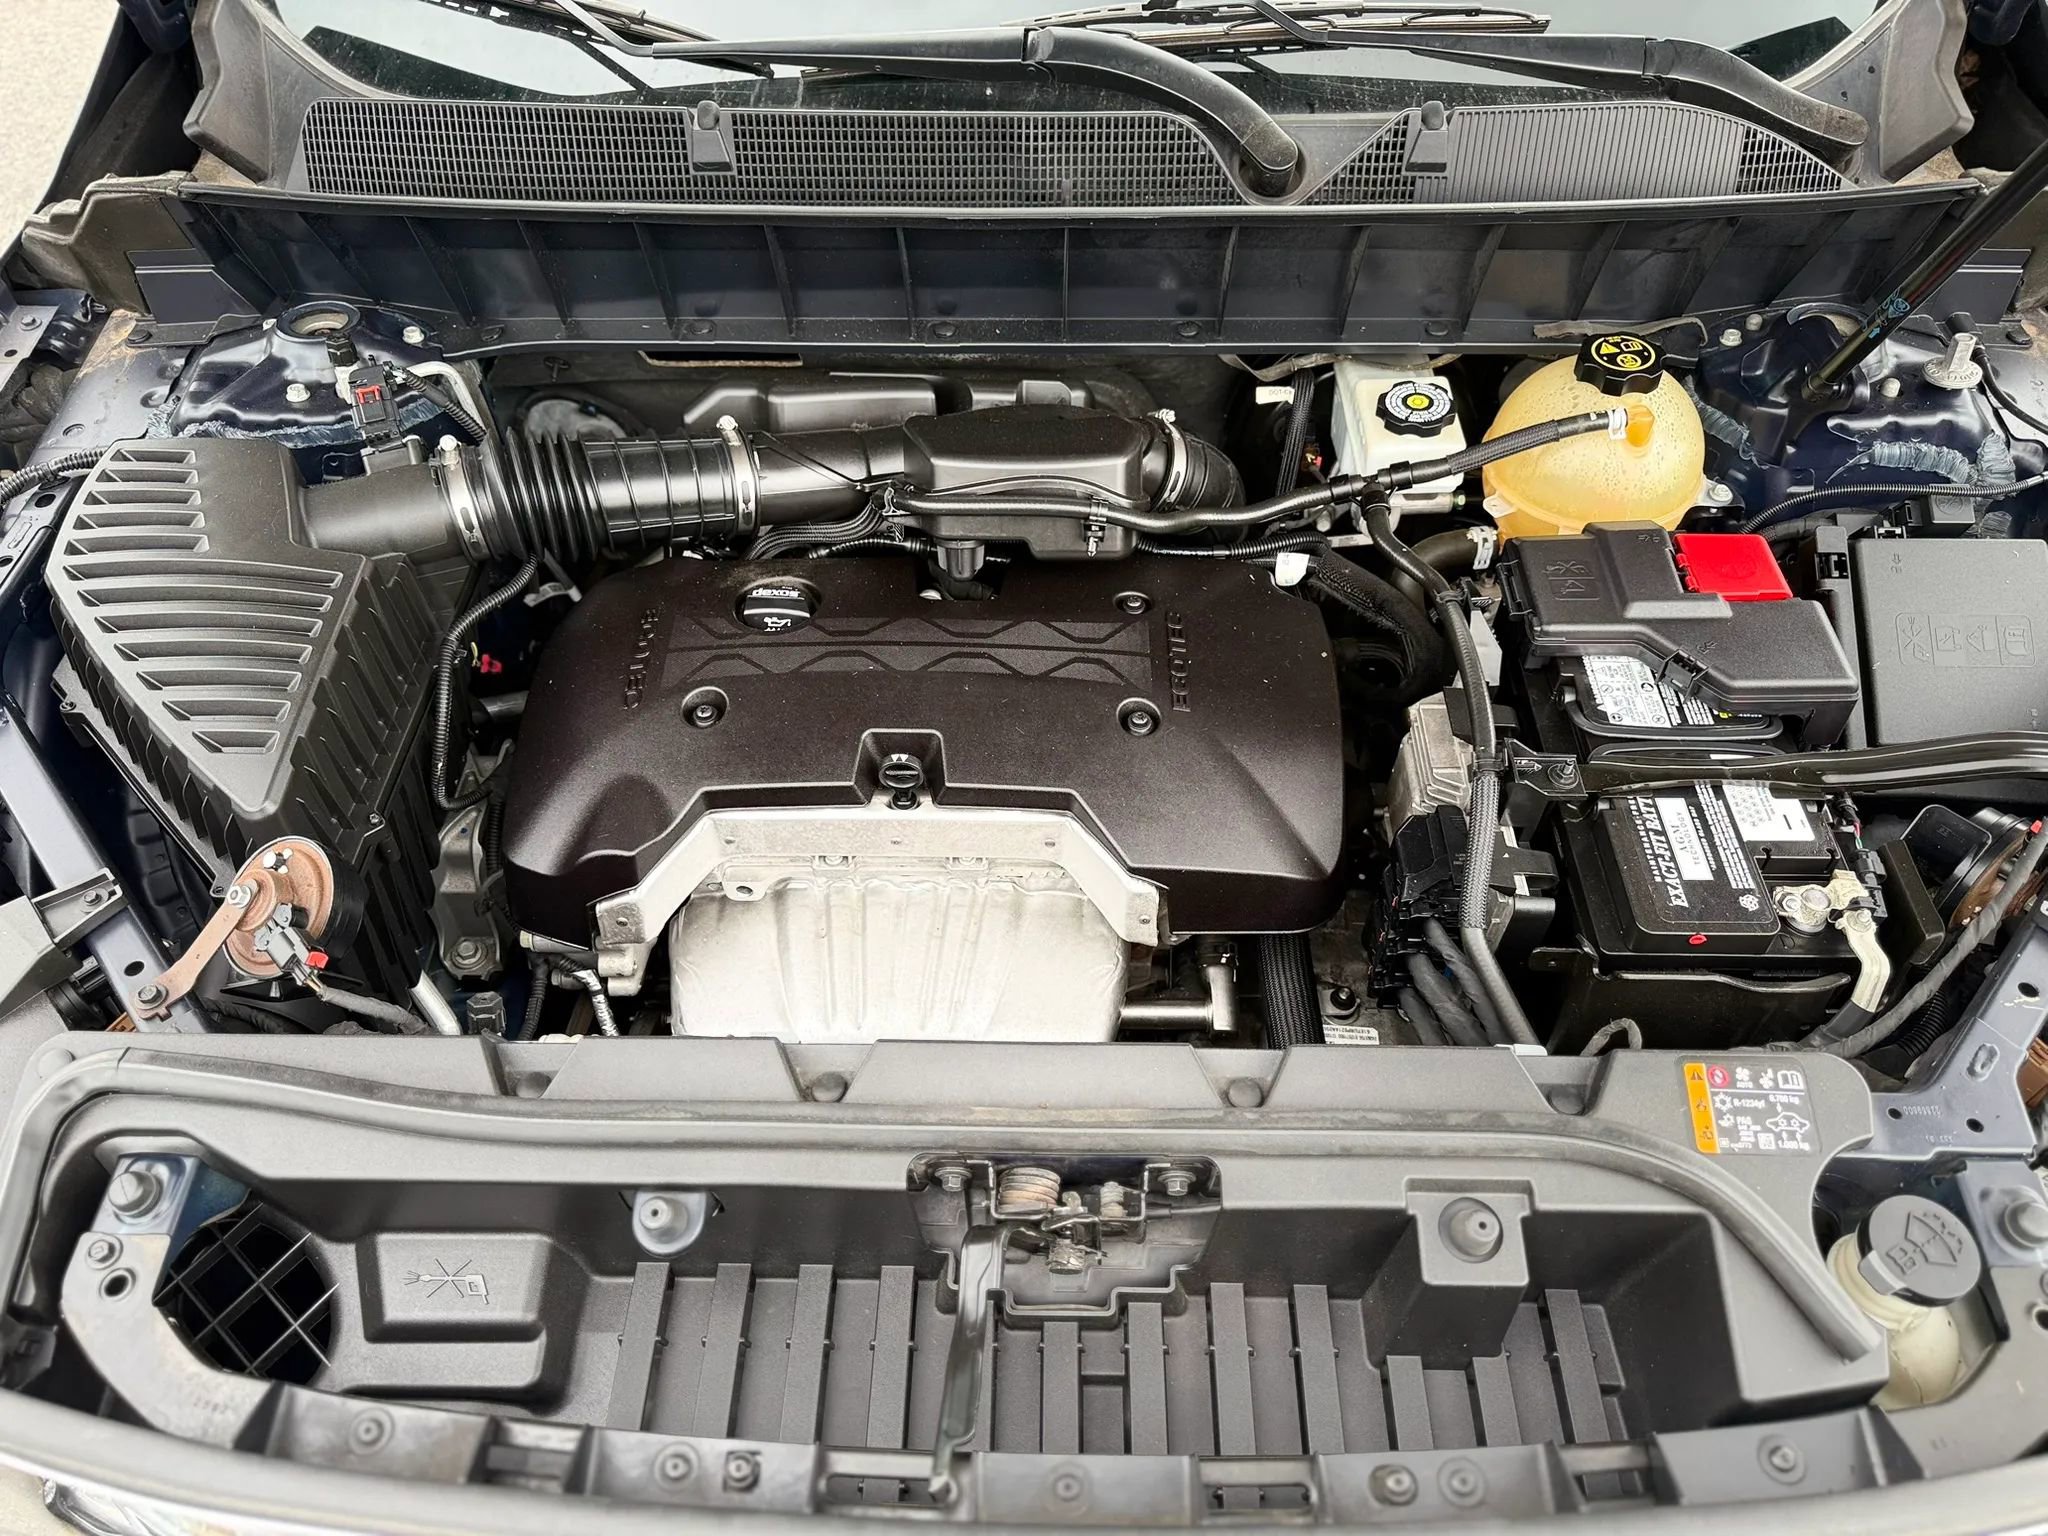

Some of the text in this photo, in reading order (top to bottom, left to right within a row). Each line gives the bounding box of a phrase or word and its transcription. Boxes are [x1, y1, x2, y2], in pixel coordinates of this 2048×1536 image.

[752, 588, 800, 598] dexos
[1671, 824, 1690, 852] AGM
[1676, 811, 1700, 865] TECHNOLOGY
[1649, 831, 1689, 907] EXACT-FIT
